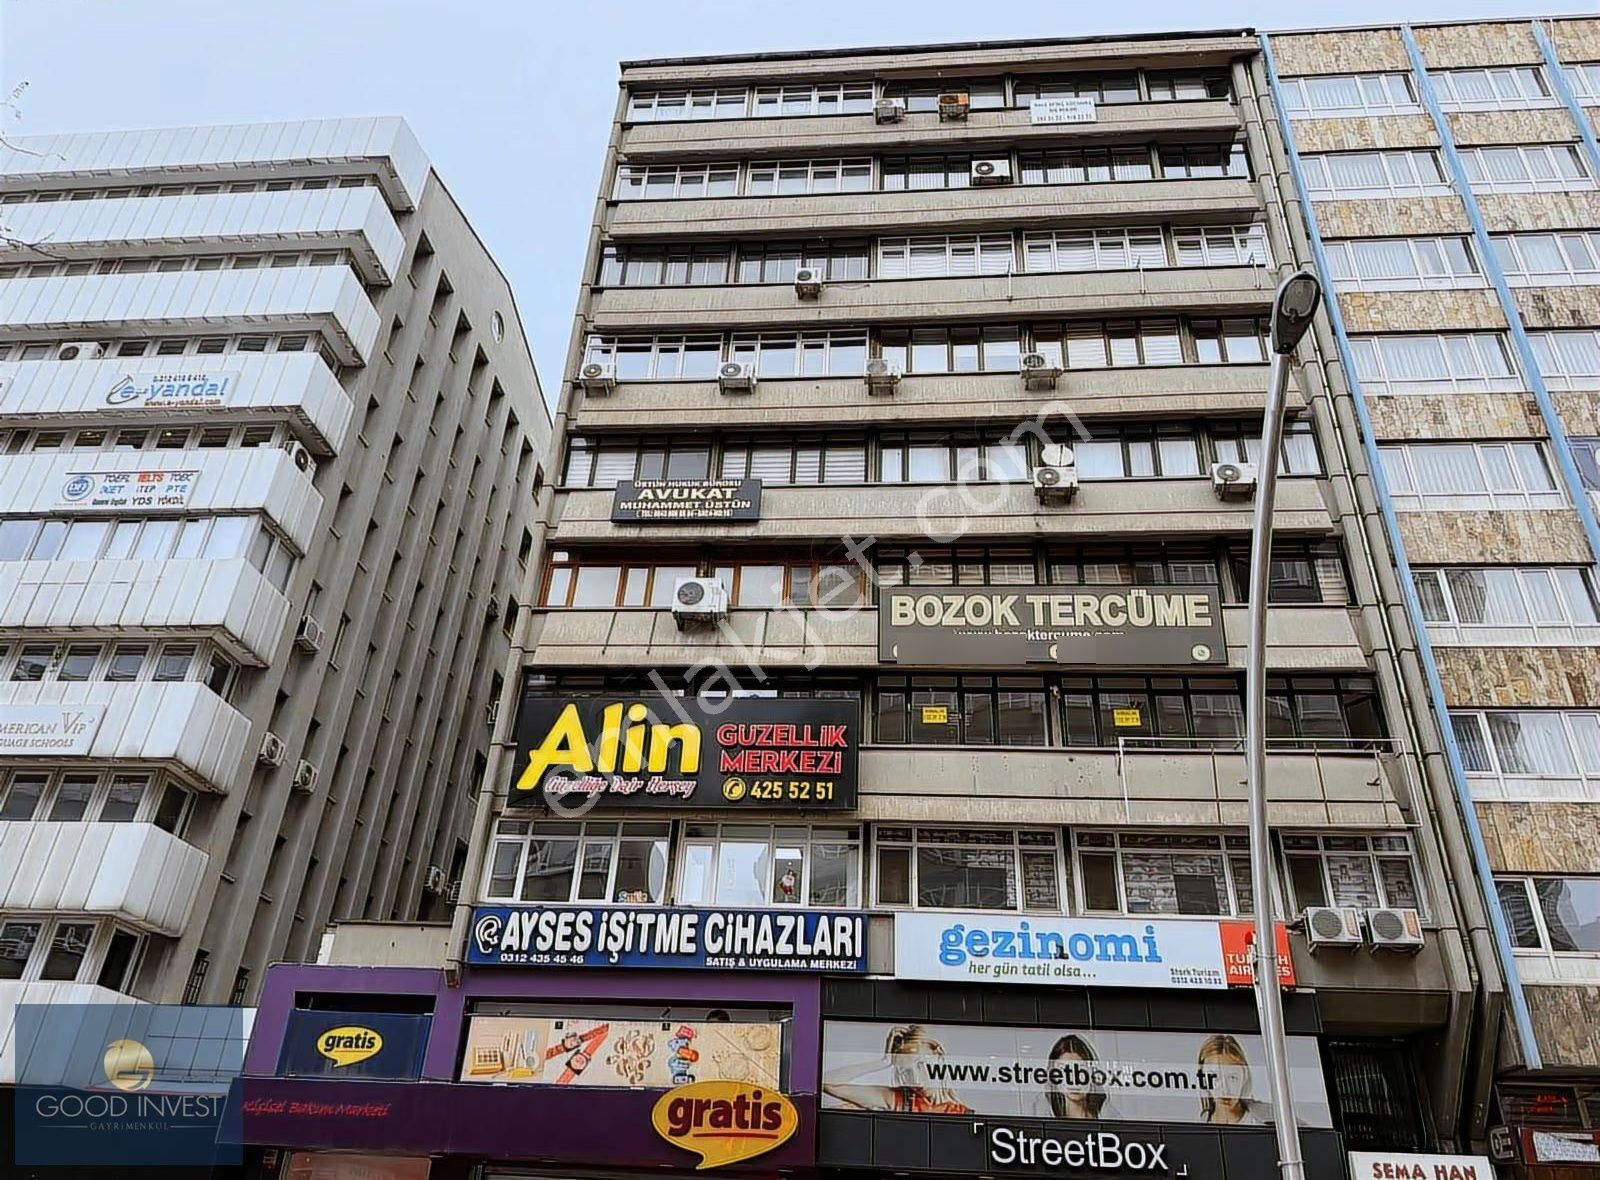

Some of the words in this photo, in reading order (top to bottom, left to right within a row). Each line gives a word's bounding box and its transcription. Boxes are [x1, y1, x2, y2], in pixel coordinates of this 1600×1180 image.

[132, 496, 153, 505] YDS
[637, 488, 737, 500] AVUKAT
[620, 501, 701, 510] MUHAMMET
[705, 499, 751, 509] ÜSTÜN
[891, 595, 1021, 626] BOZOK
[1026, 589, 1213, 627] TERCÜME
[29, 738, 74, 748] SCHOOLS
[516, 702, 700, 790] Alin
[720, 750, 842, 774] MERKEZİ
[610, 775, 644, 795] Dair
[751, 781, 783, 799] 425
[789, 781, 810, 799] 52
[816, 782, 833, 800] 51
[500, 910, 593, 953] AYSES
[598, 911, 698, 963] İŞİTME
[704, 912, 862, 958] CİHAZLARI
[939, 921, 1163, 966] gezinomi
[500, 954, 528, 963] 0312
[530, 954, 551, 964] 435
[553, 955, 568, 964] 45
[570, 955, 584, 965] 46
[705, 957, 736, 969] SATIŞ
[750, 958, 808, 969] UYGULAMA
[968, 961, 991, 974] her
[993, 961, 1019, 978] gün
[1021, 962, 1051, 976] tatil
[1053, 964, 1097, 978] olsa...
[324, 1031, 376, 1052] gratis
[926, 1061, 1218, 1091] www.streetbox.com.tr
[668, 1090, 783, 1137] gratis
[991, 1128, 1168, 1170] StreetBox
[1372, 1162, 1427, 1180] SEMA
[1433, 1164, 1478, 1180] HAN
